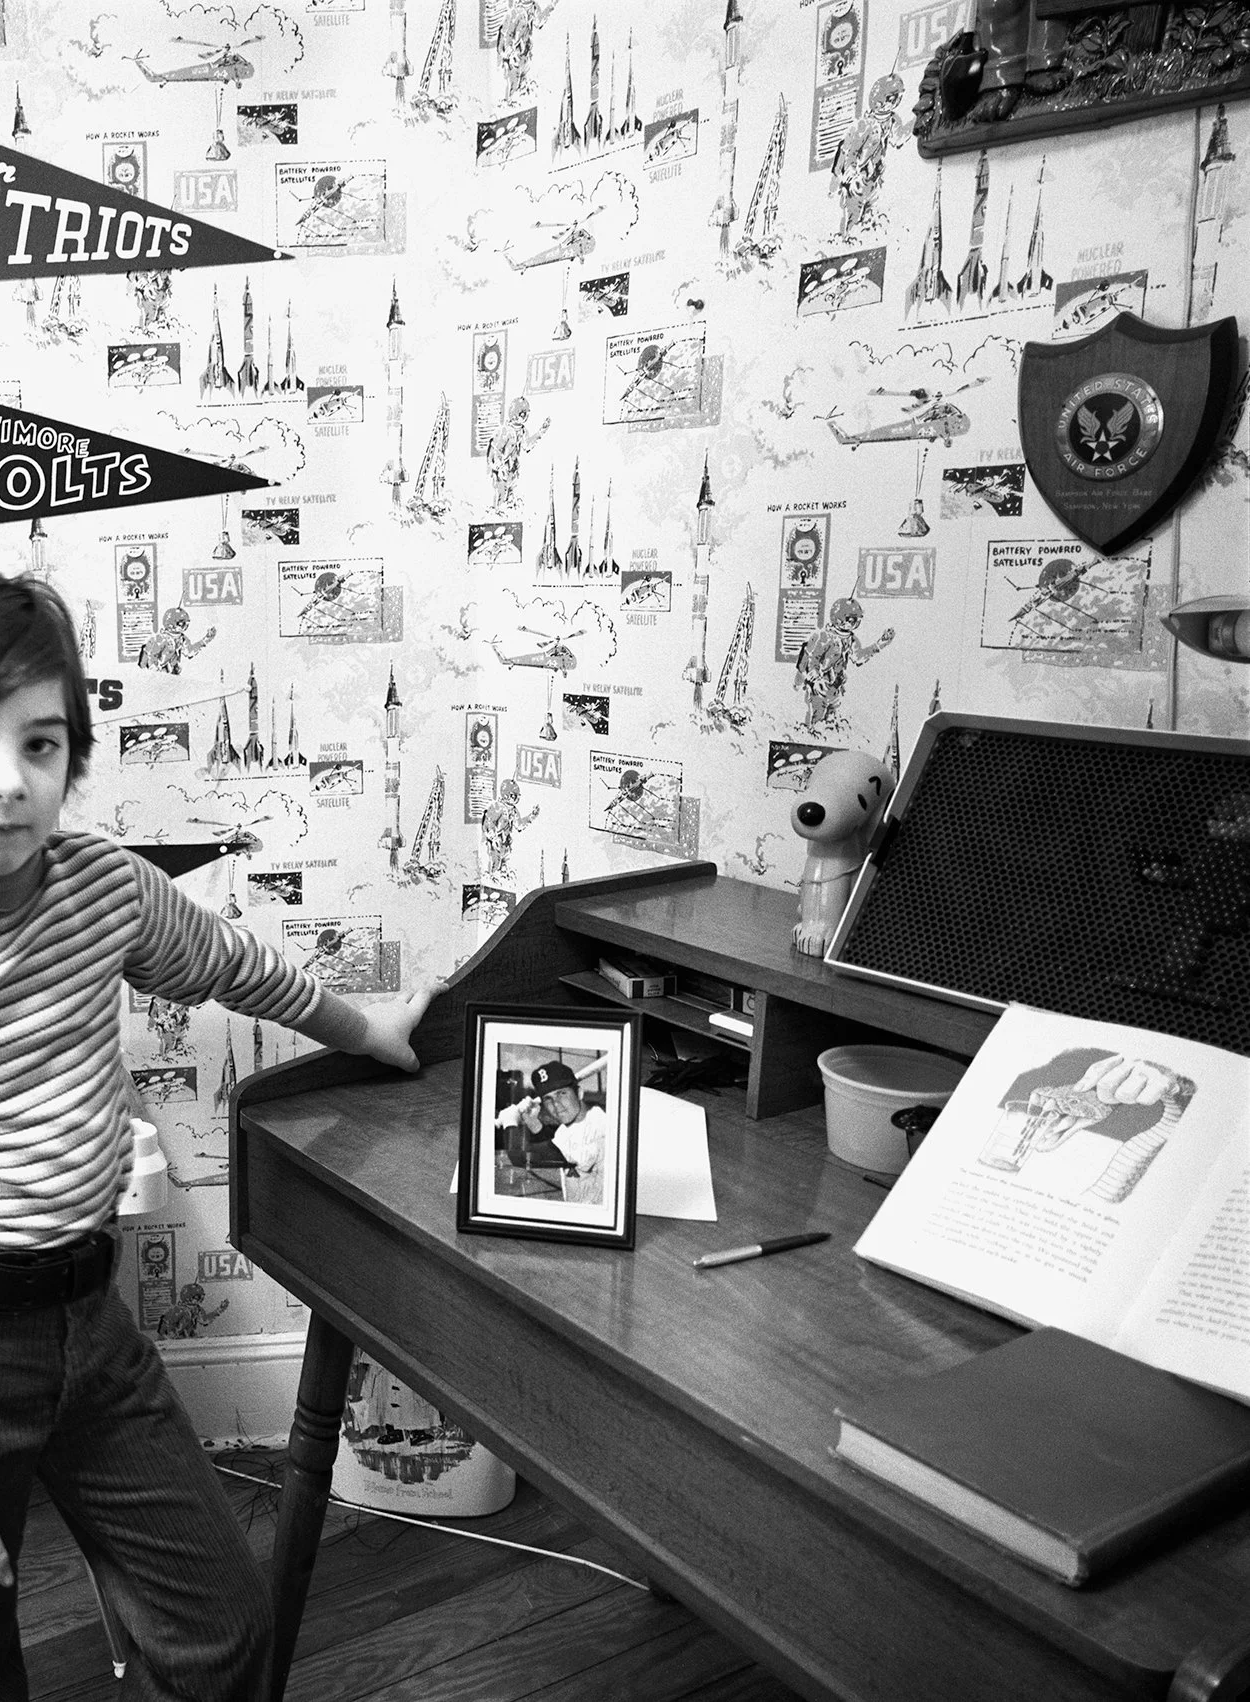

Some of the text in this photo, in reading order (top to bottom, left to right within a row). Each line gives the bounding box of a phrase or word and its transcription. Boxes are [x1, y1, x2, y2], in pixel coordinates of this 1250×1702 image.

[313, 14, 350, 27] SATELLITE
[137, 130, 160, 138] WORKS
[279, 165, 341, 175] BATTERY POWERED
[281, 175, 316, 183] SATELLITES
[180, 175, 232, 205] USA
[609, 333, 664, 349] BATTERY POWERED
[531, 354, 571, 385] USA
[1058, 379, 1158, 430] UNITED STATES
[314, 425, 349, 437] SATELLITE
[1063, 447, 1147, 477] AIR FORCE
[793, 502, 819, 510] ROCKET
[822, 501, 847, 509] WORKS
[992, 545, 1082, 556] BATTERY POWERED
[282, 565, 308, 573] BATTERY
[993, 558, 1044, 567] SATELLITES
[283, 572, 316, 580] SATELLITES
[865, 555, 928, 589] USA
[189, 572, 238, 600] USA
[626, 613, 657, 626] SATELLITE
[521, 751, 557, 780] USA
[592, 755, 644, 768] BATTERY POWERED
[316, 797, 350, 808] SATELLITE
[285, 920, 341, 930] BATTERY POWERED
[538, 1068, 549, 1083] B
[204, 1255, 250, 1275] USA
